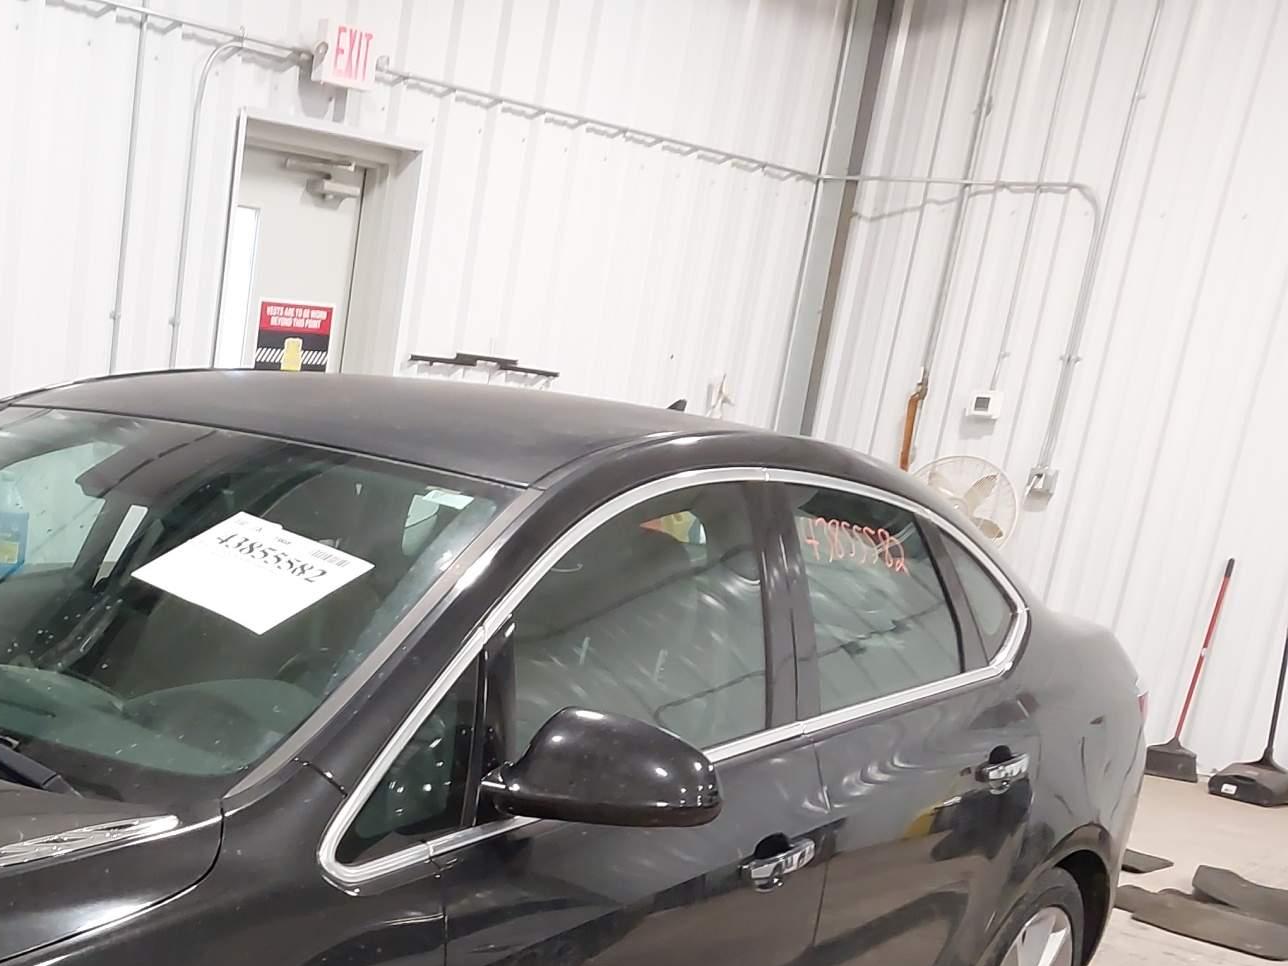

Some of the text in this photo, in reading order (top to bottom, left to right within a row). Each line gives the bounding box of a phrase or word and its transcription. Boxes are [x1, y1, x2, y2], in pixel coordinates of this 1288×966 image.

[333, 25, 373, 80] EXIT
[266, 305, 284, 316] VESTS
[284, 306, 295, 317] ARE
[295, 308, 303, 318] TO
[303, 309, 310, 318] BE
[270, 316, 322, 329] BEYOND THIS POINT
[215, 532, 329, 584] 43855582
